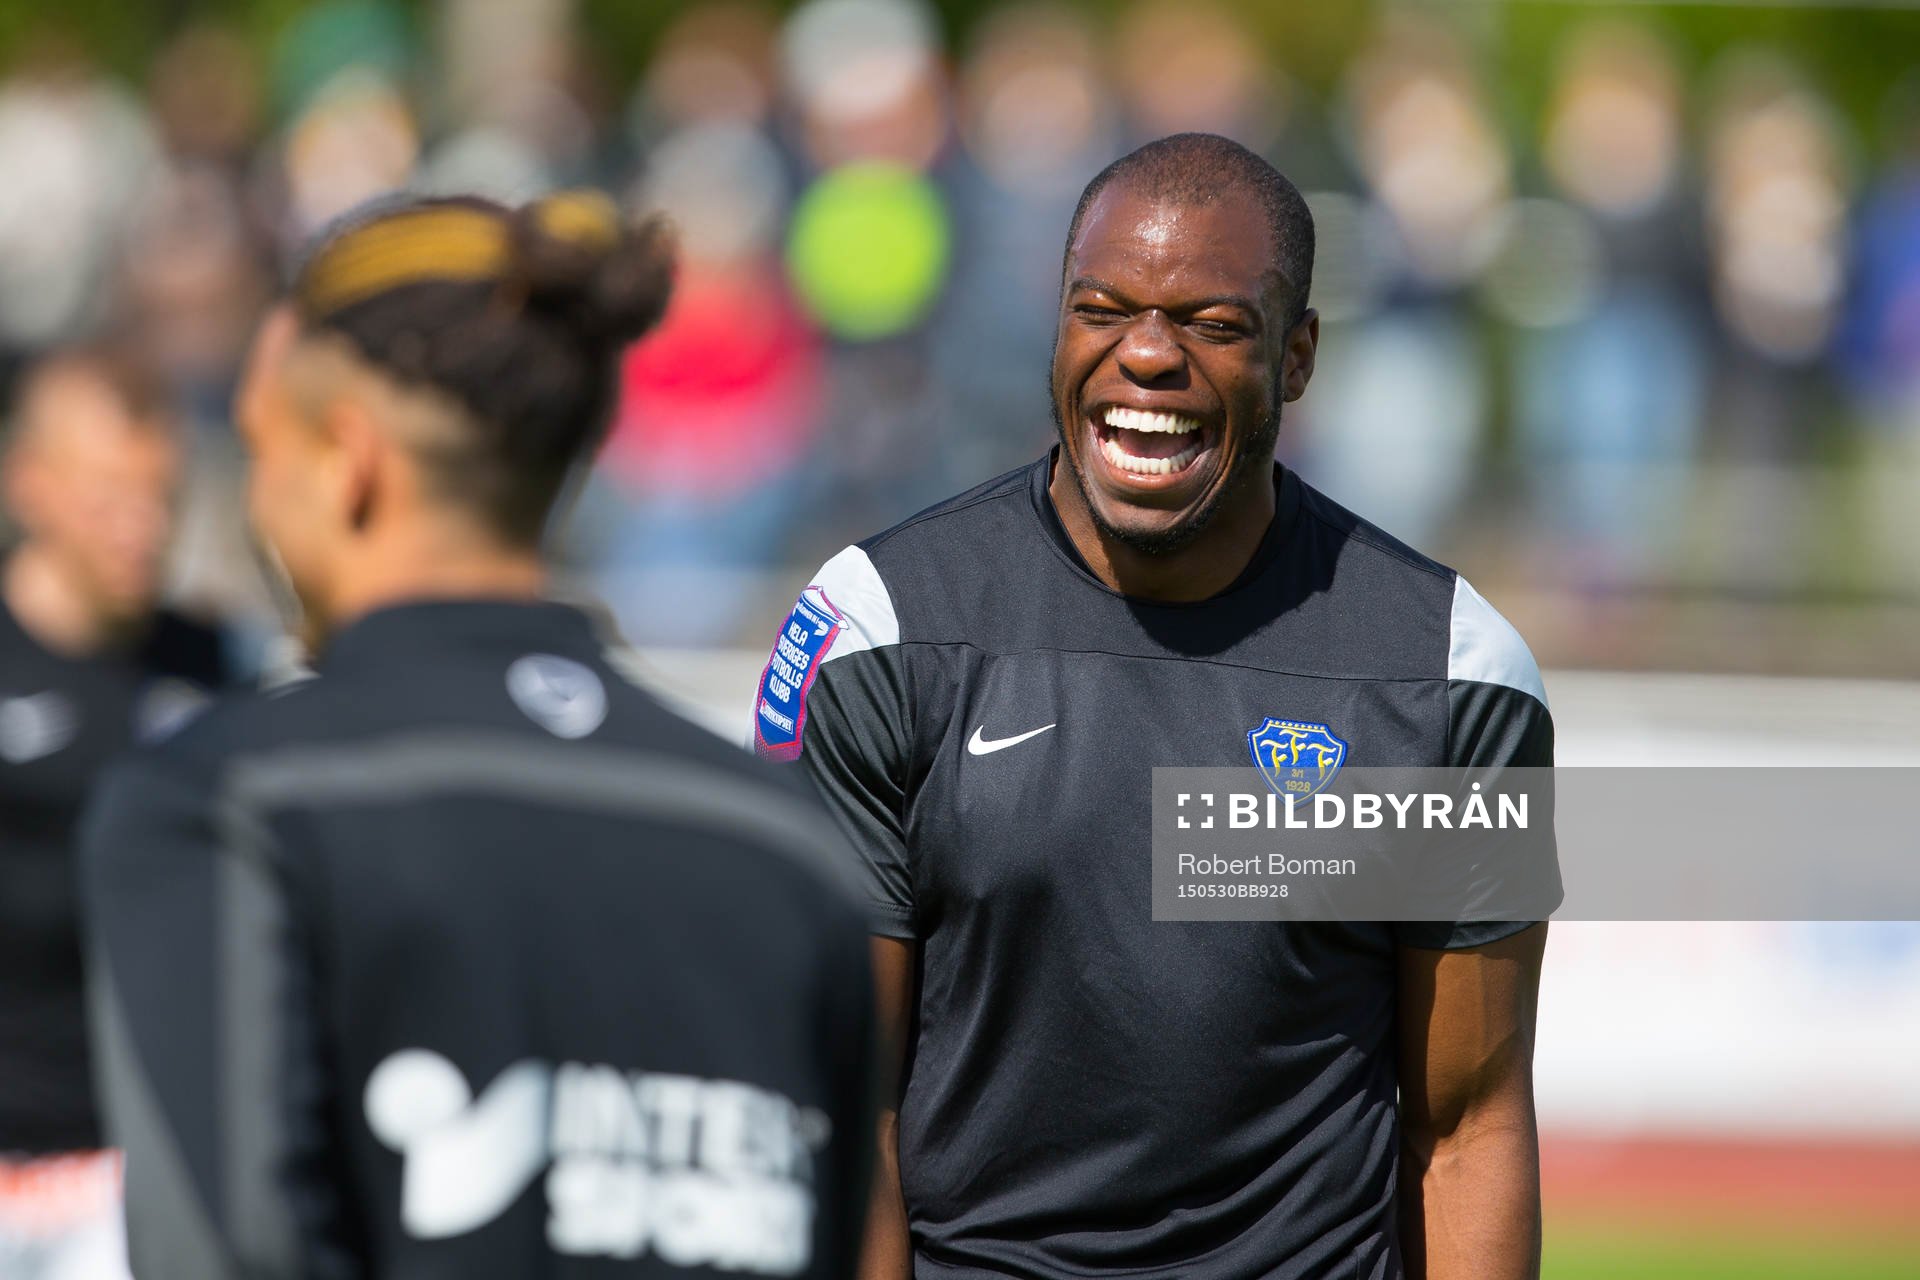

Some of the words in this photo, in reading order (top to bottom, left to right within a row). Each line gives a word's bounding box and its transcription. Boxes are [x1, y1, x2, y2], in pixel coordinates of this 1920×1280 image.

[788, 621, 808, 646] HELA
[778, 634, 810, 670] SVERIGES
[769, 673, 790, 703] KLUBB
[1285, 780, 1311, 793] 1928
